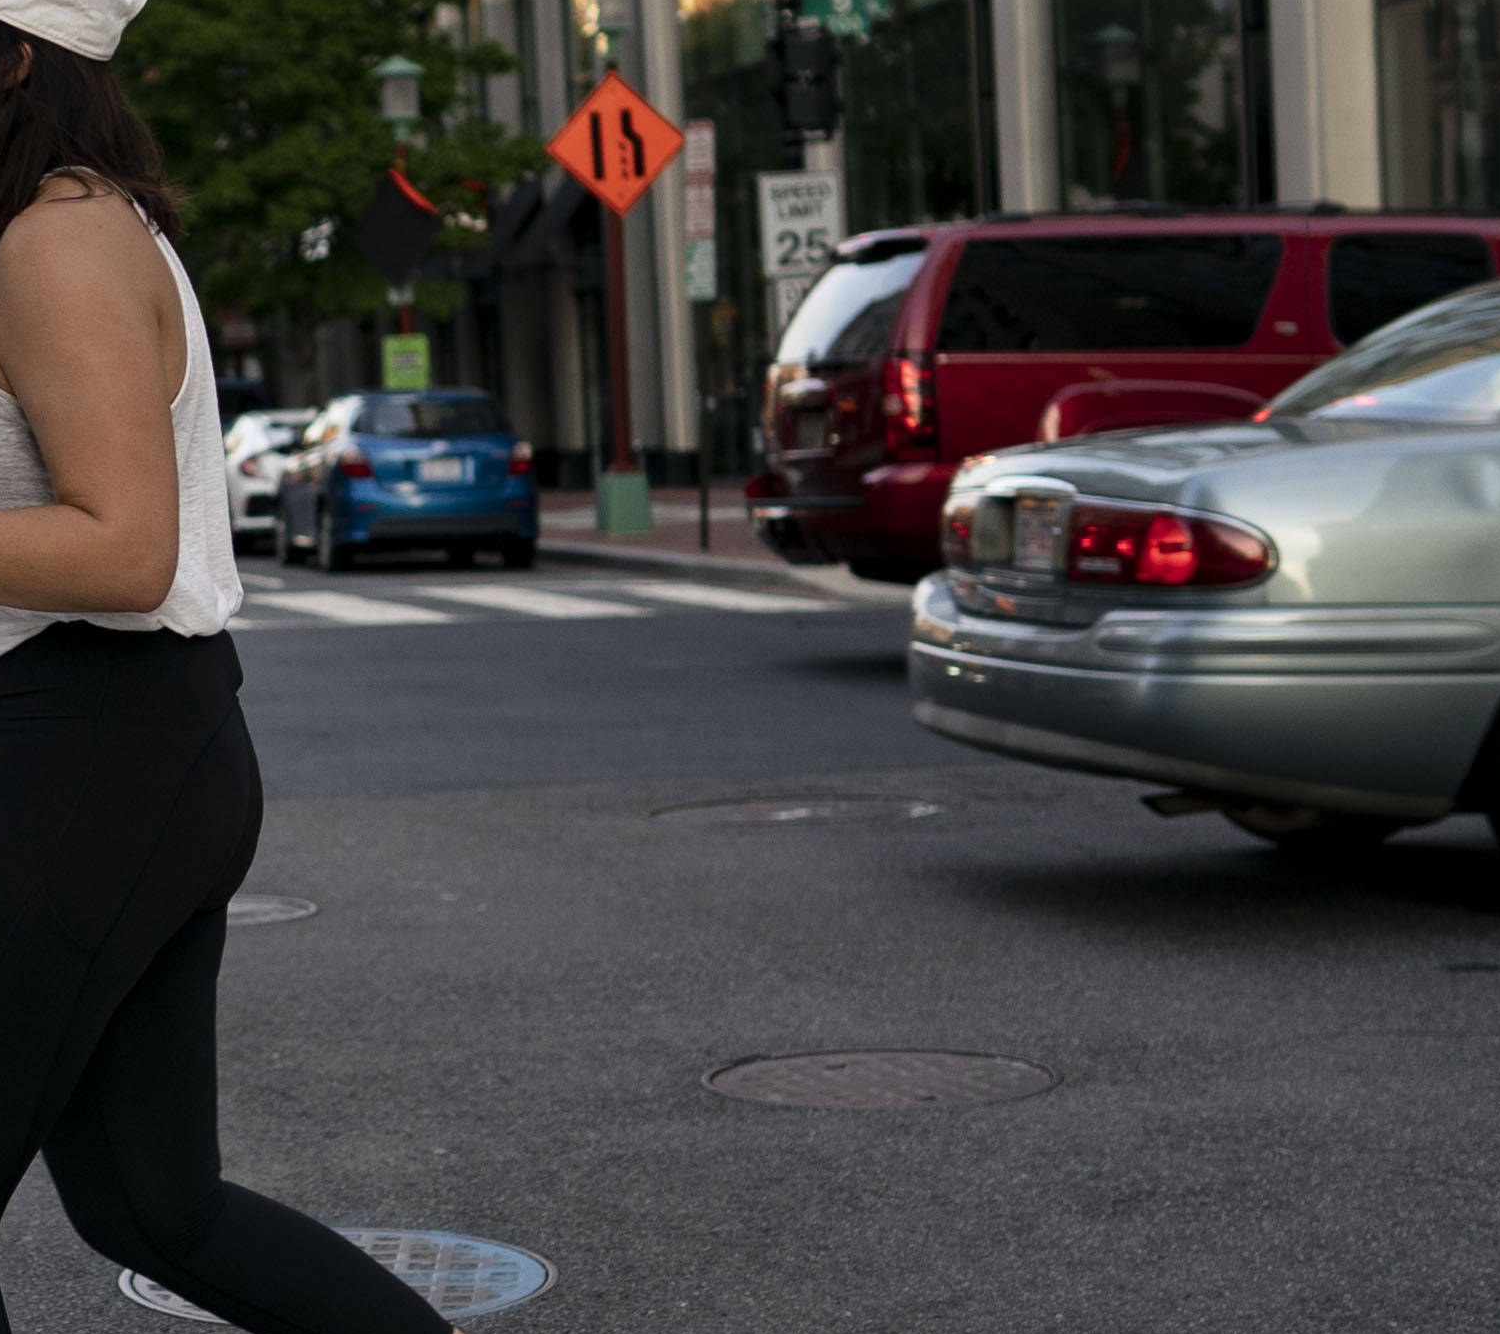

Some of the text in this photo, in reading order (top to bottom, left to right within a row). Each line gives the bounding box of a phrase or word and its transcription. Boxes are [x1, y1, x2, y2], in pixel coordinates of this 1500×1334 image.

[770, 183, 830, 201] SPEED
[777, 202, 823, 219] LIMIT
[777, 229, 829, 265] 25
